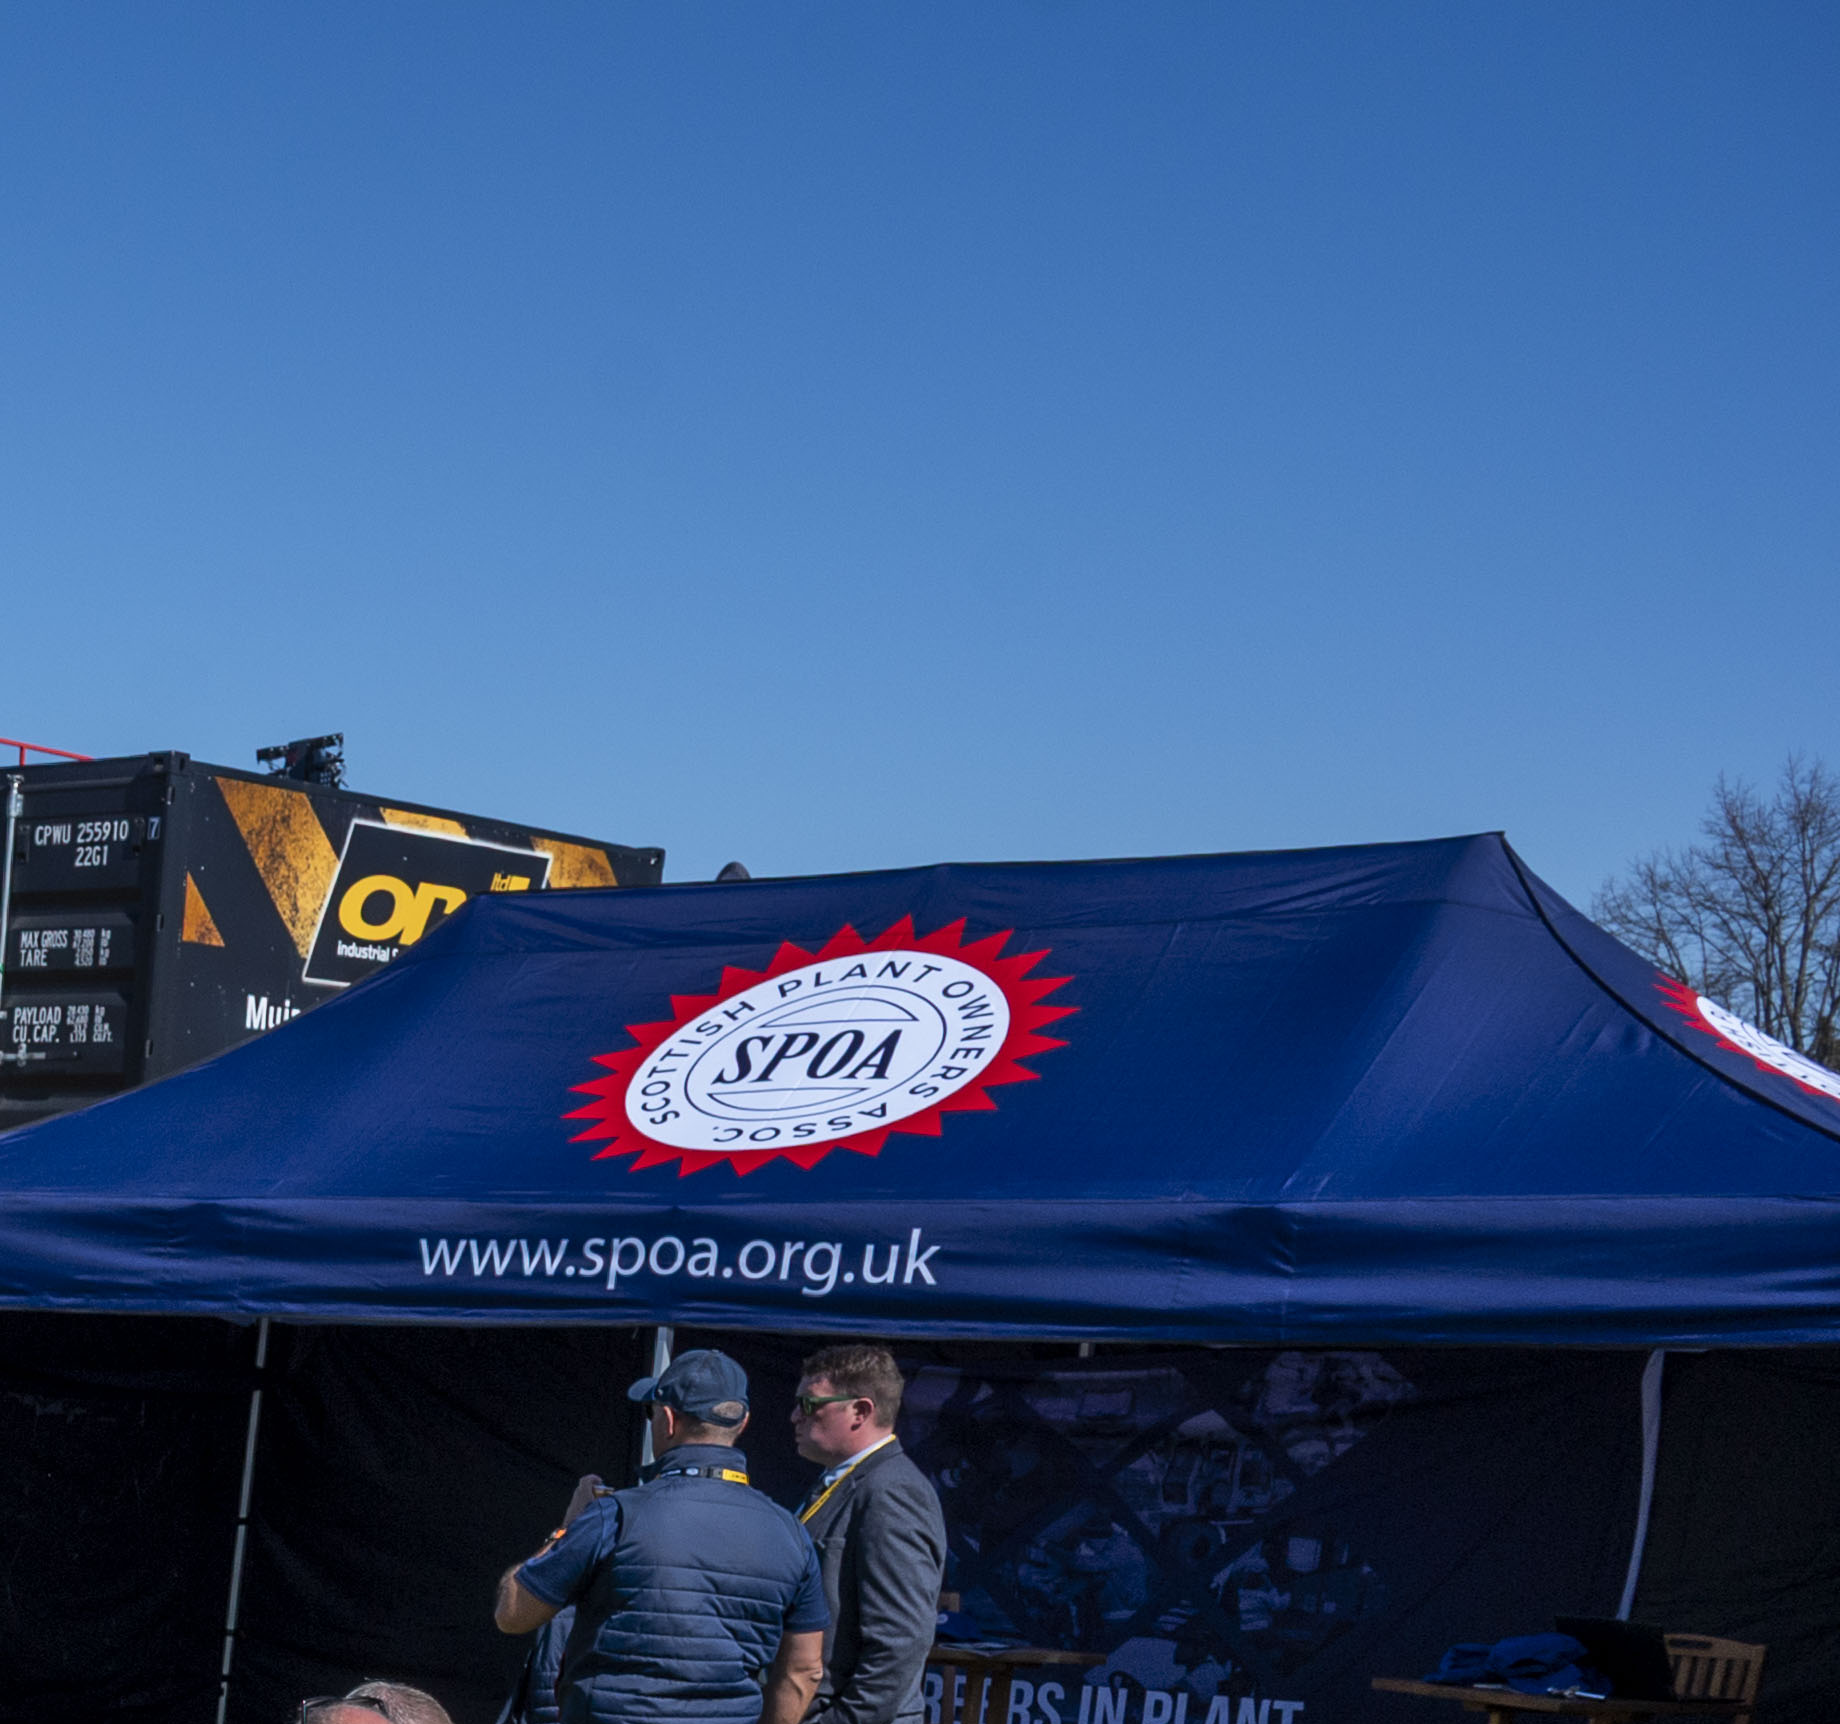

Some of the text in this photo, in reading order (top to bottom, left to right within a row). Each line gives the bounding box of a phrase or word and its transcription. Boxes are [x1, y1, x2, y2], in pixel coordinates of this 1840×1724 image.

[34, 817, 160, 846] CPWU 255910 7
[74, 845, 108, 867] 22G1
[338, 874, 468, 945] or
[20, 930, 39, 948] MAX
[41, 930, 68, 948] GROSS
[20, 948, 48, 967] TARE
[14, 1006, 62, 1025] PAYLOAD
[641, 1000, 756, 1125] SCOTTISH
[777, 960, 943, 998] PLANT
[908, 980, 995, 1099] OWNERS
[711, 1029, 903, 1085] SPOA
[419, 1228, 942, 1298] www.spoa.org.uk
